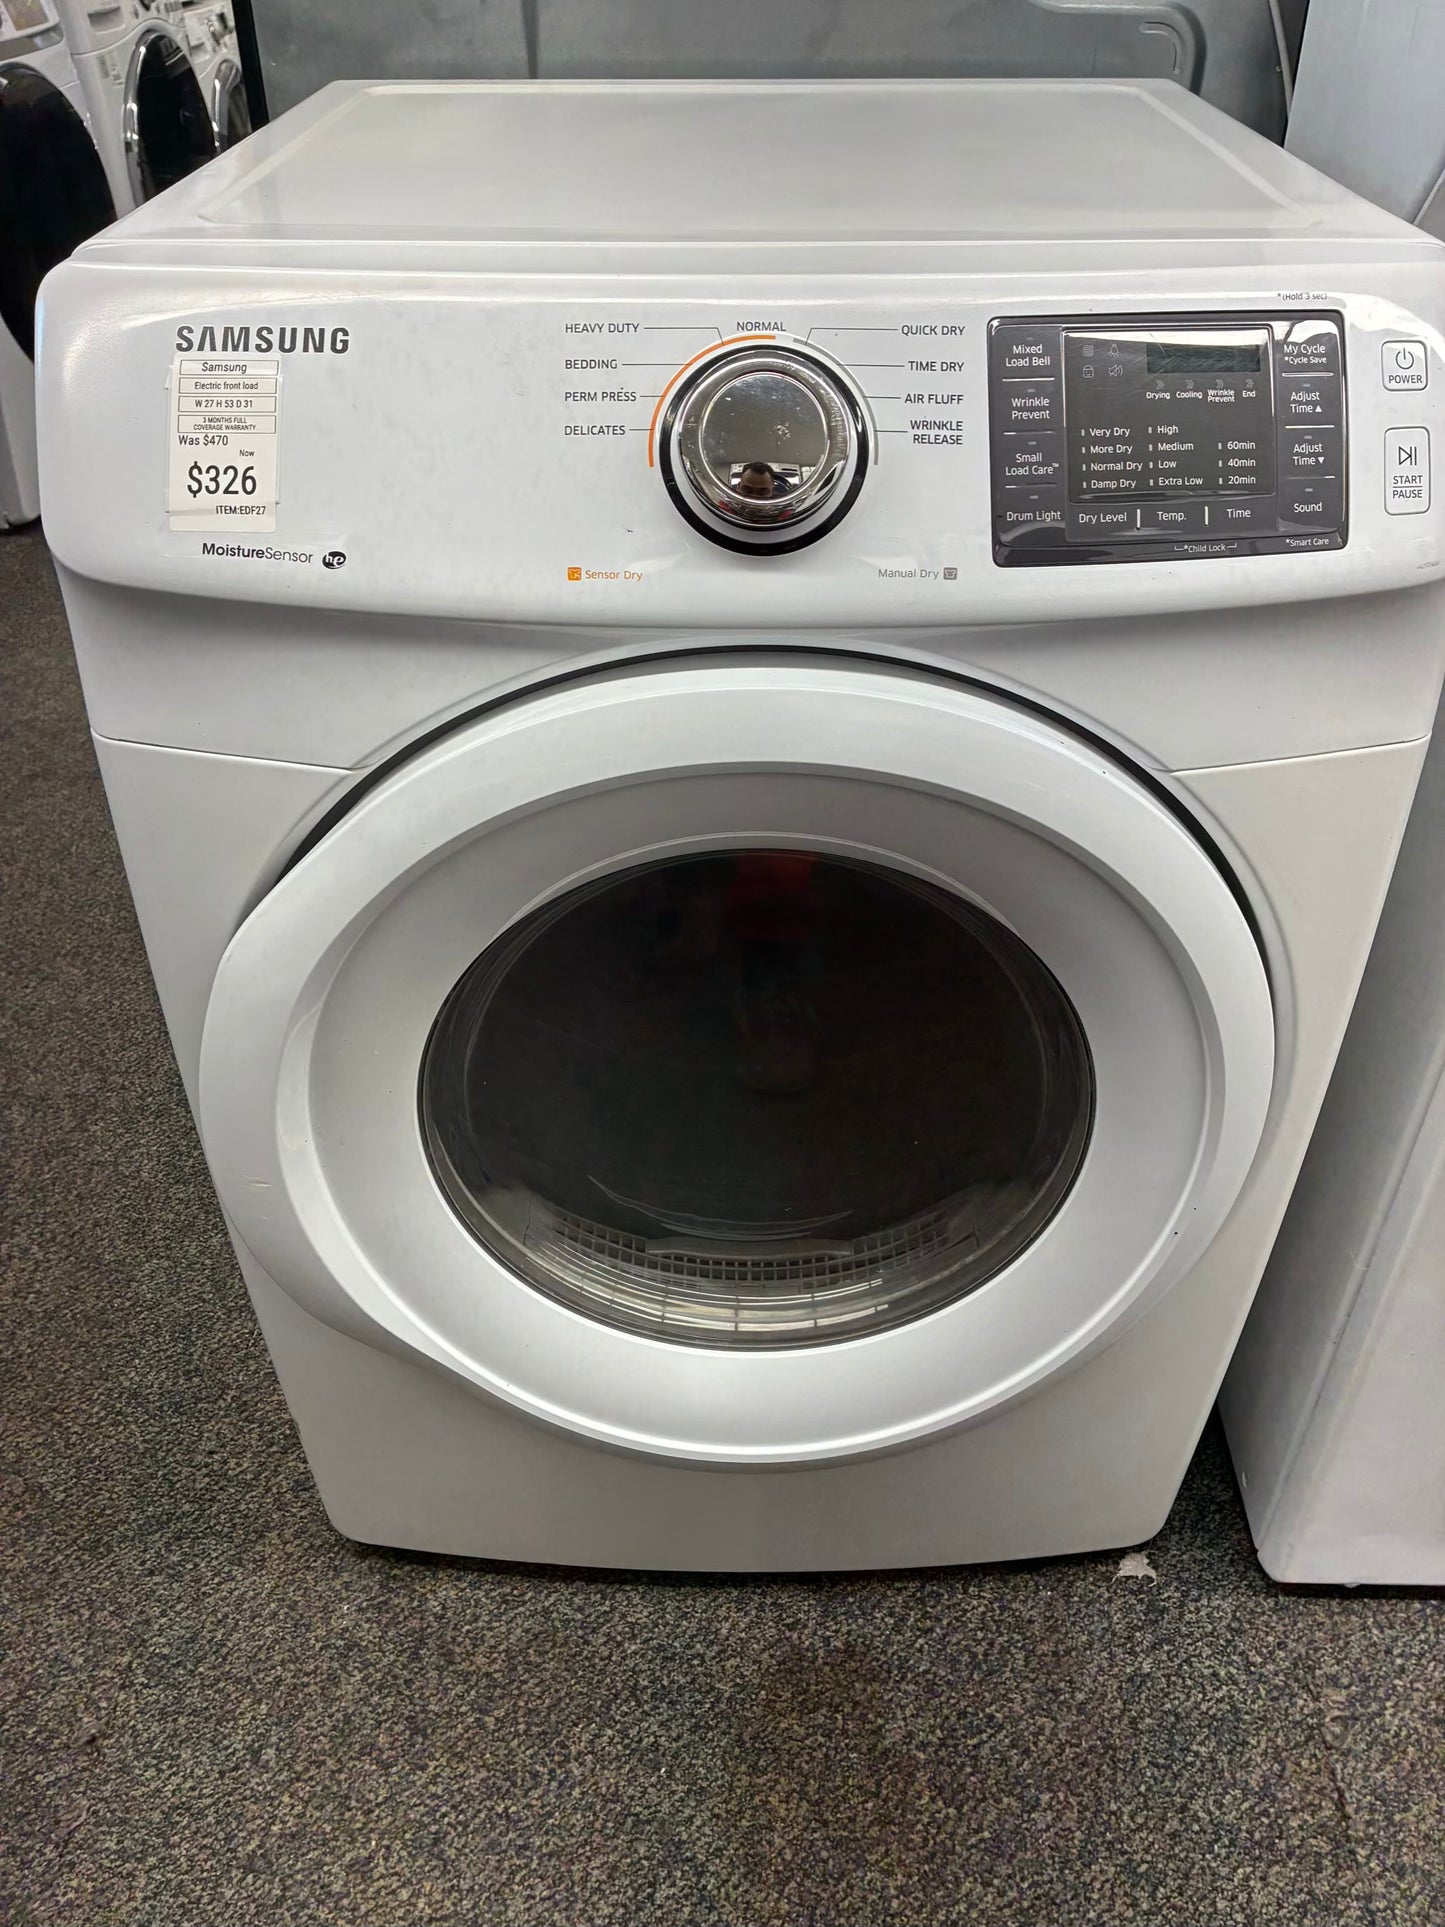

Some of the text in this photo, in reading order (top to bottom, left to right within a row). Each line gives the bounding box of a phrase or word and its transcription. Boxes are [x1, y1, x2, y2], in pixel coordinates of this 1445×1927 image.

[565, 323, 639, 333] HEAVY DUTY
[737, 322, 786, 331] NORMAL
[901, 325, 965, 336] QUICK DRY
[176, 326, 350, 354] SAMSUNG
[1013, 344, 1042, 353] Mixed
[1284, 344, 1326, 355] My Cycle
[565, 360, 617, 369] BEDDING
[1006, 356, 1050, 366] Load Bell
[1309, 356, 1326, 364] Save
[202, 362, 247, 374] Samsung
[909, 361, 964, 371] TIME DRY
[1388, 375, 1422, 384] POWER
[195, 382, 258, 390] Electric front load
[565, 392, 636, 401] PERM PRESS
[904, 393, 964, 404] AIR FLUFF
[1146, 391, 1170, 400] Drying
[1176, 391, 1202, 399] Cooling
[1291, 392, 1320, 403] Adjust
[195, 400, 253, 408] W 27 H 53 D 31
[1012, 397, 1049, 407] Wrinkle
[1290, 404, 1313, 413] Time
[1012, 410, 1050, 419] Prevent
[564, 425, 625, 435] DELICATES
[910, 420, 963, 431] WRINKLE
[1158, 425, 1179, 435] High
[1090, 427, 1130, 438] Very Dry
[178, 434, 228, 446] Was $470
[913, 434, 963, 445] RELEASE
[1090, 445, 1132, 454] More Dry
[1158, 442, 1194, 451] Medium
[1227, 441, 1255, 450] 60min
[1293, 443, 1323, 454] Adjust
[239, 449, 255, 457] Now
[1016, 453, 1042, 462] Small
[1158, 460, 1176, 468] Low
[1228, 458, 1256, 467] 40min
[1293, 456, 1315, 465] Time
[1006, 466, 1028, 475] Load
[1091, 462, 1143, 471] Normal Dry
[187, 461, 257, 498] $326
[1159, 477, 1203, 486] Extra Low
[1228, 476, 1256, 485] 20min
[1393, 475, 1423, 485] START
[1091, 480, 1136, 489] Damp Dry
[1393, 490, 1422, 498] PAUSE
[216, 505, 266, 515] ITEM:EDF27
[1294, 503, 1322, 512] Sound
[1006, 511, 1061, 522] Drum Light
[1079, 512, 1127, 524] Dry Level
[1157, 511, 1187, 522] Temp.
[1227, 509, 1251, 518] Time
[202, 542, 313, 563] MoistureSensor
[585, 570, 643, 582] Sensor Dry
[878, 568, 939, 580] Manual Dry
